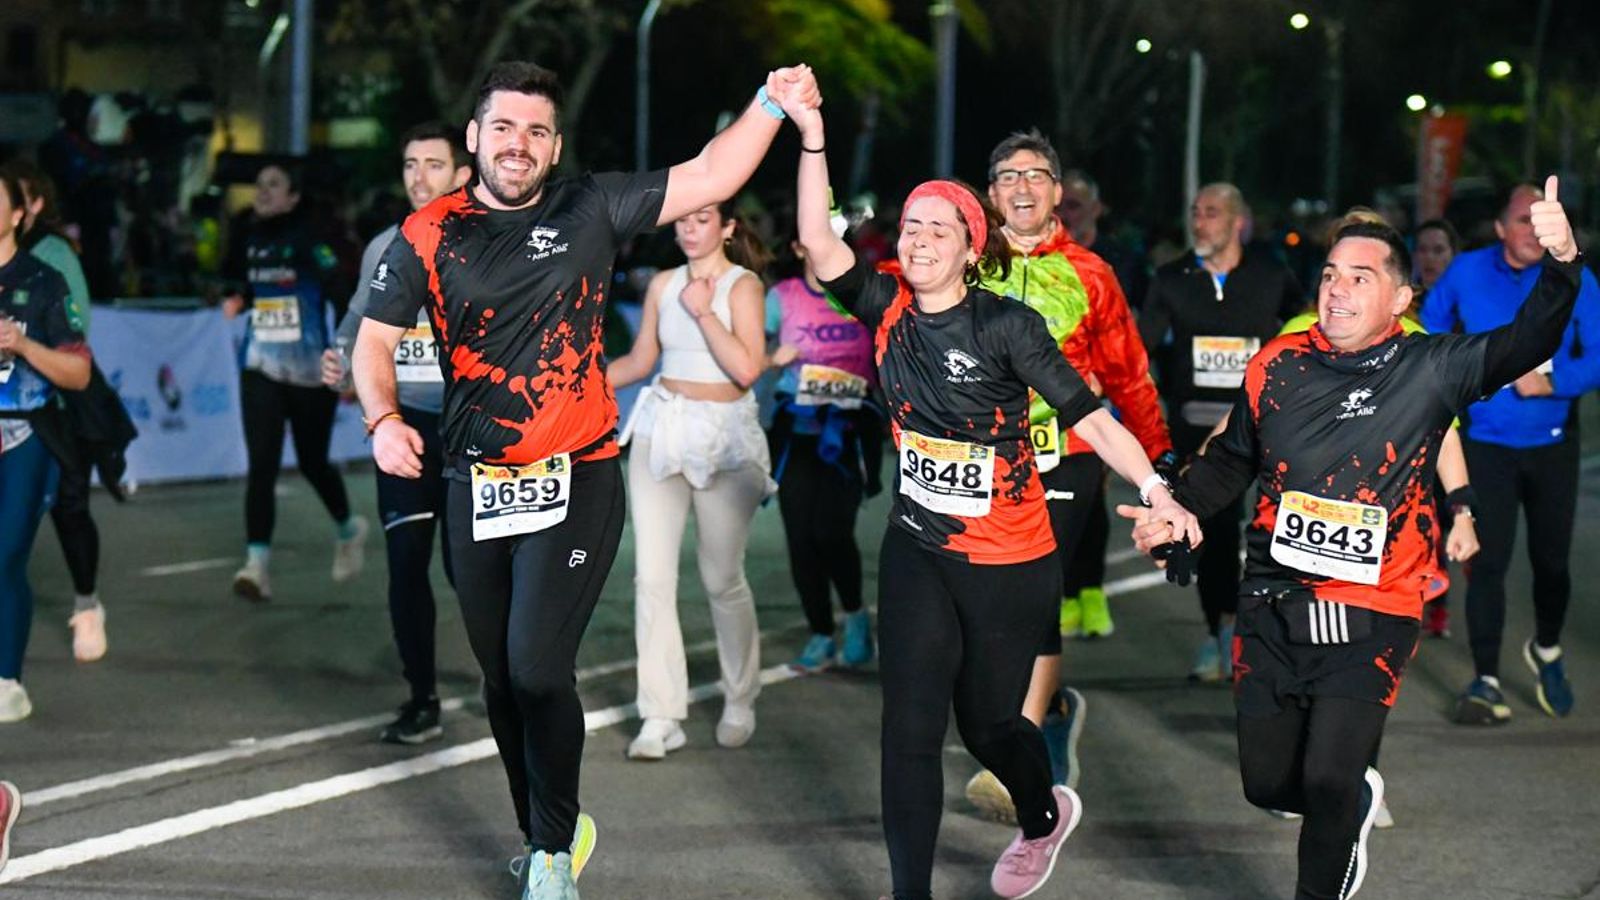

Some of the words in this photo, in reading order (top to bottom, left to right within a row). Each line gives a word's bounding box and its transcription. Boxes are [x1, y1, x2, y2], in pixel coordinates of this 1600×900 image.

[906, 448, 982, 489] 9648
[480, 477, 561, 509] 9659
[1285, 513, 1374, 555] 9643
